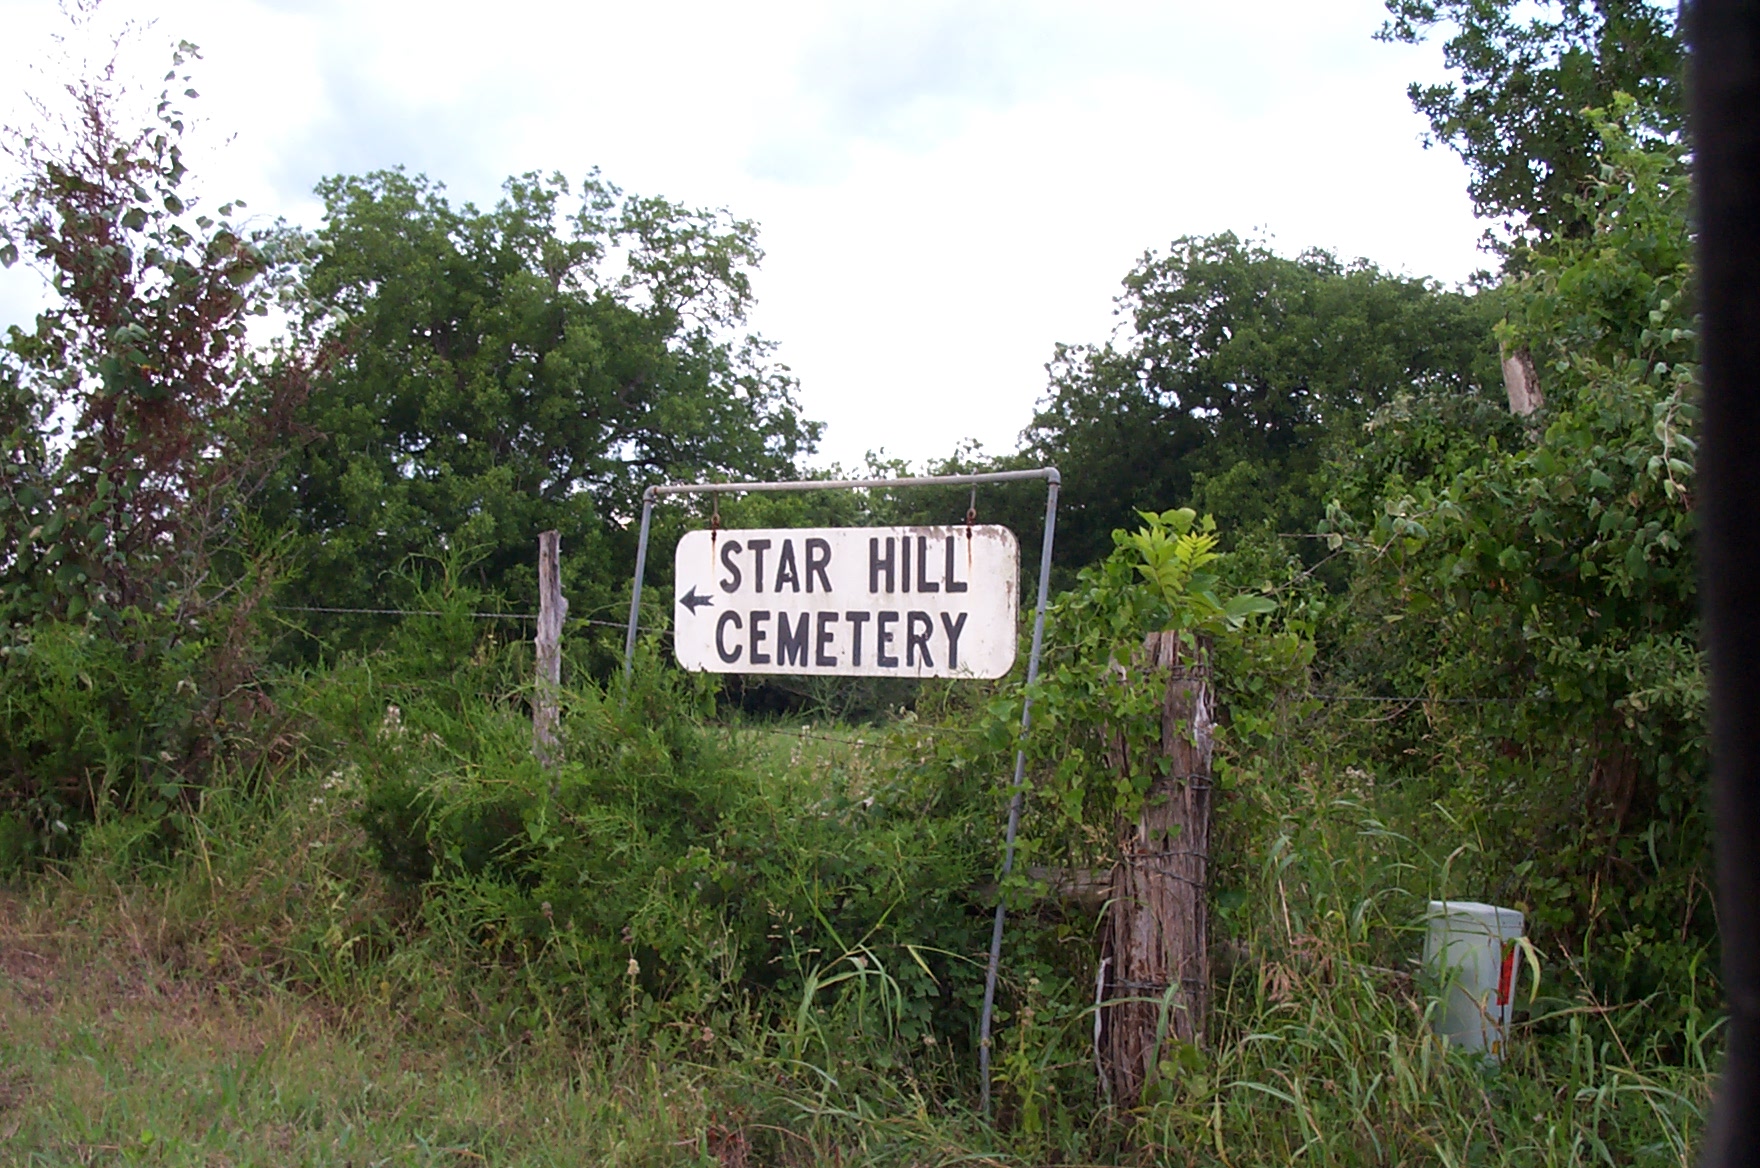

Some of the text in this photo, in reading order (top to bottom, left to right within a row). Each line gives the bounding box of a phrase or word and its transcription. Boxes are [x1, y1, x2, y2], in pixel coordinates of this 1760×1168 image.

[719, 536, 968, 594] STAR HILL
[715, 610, 968, 670] CEMETERY
